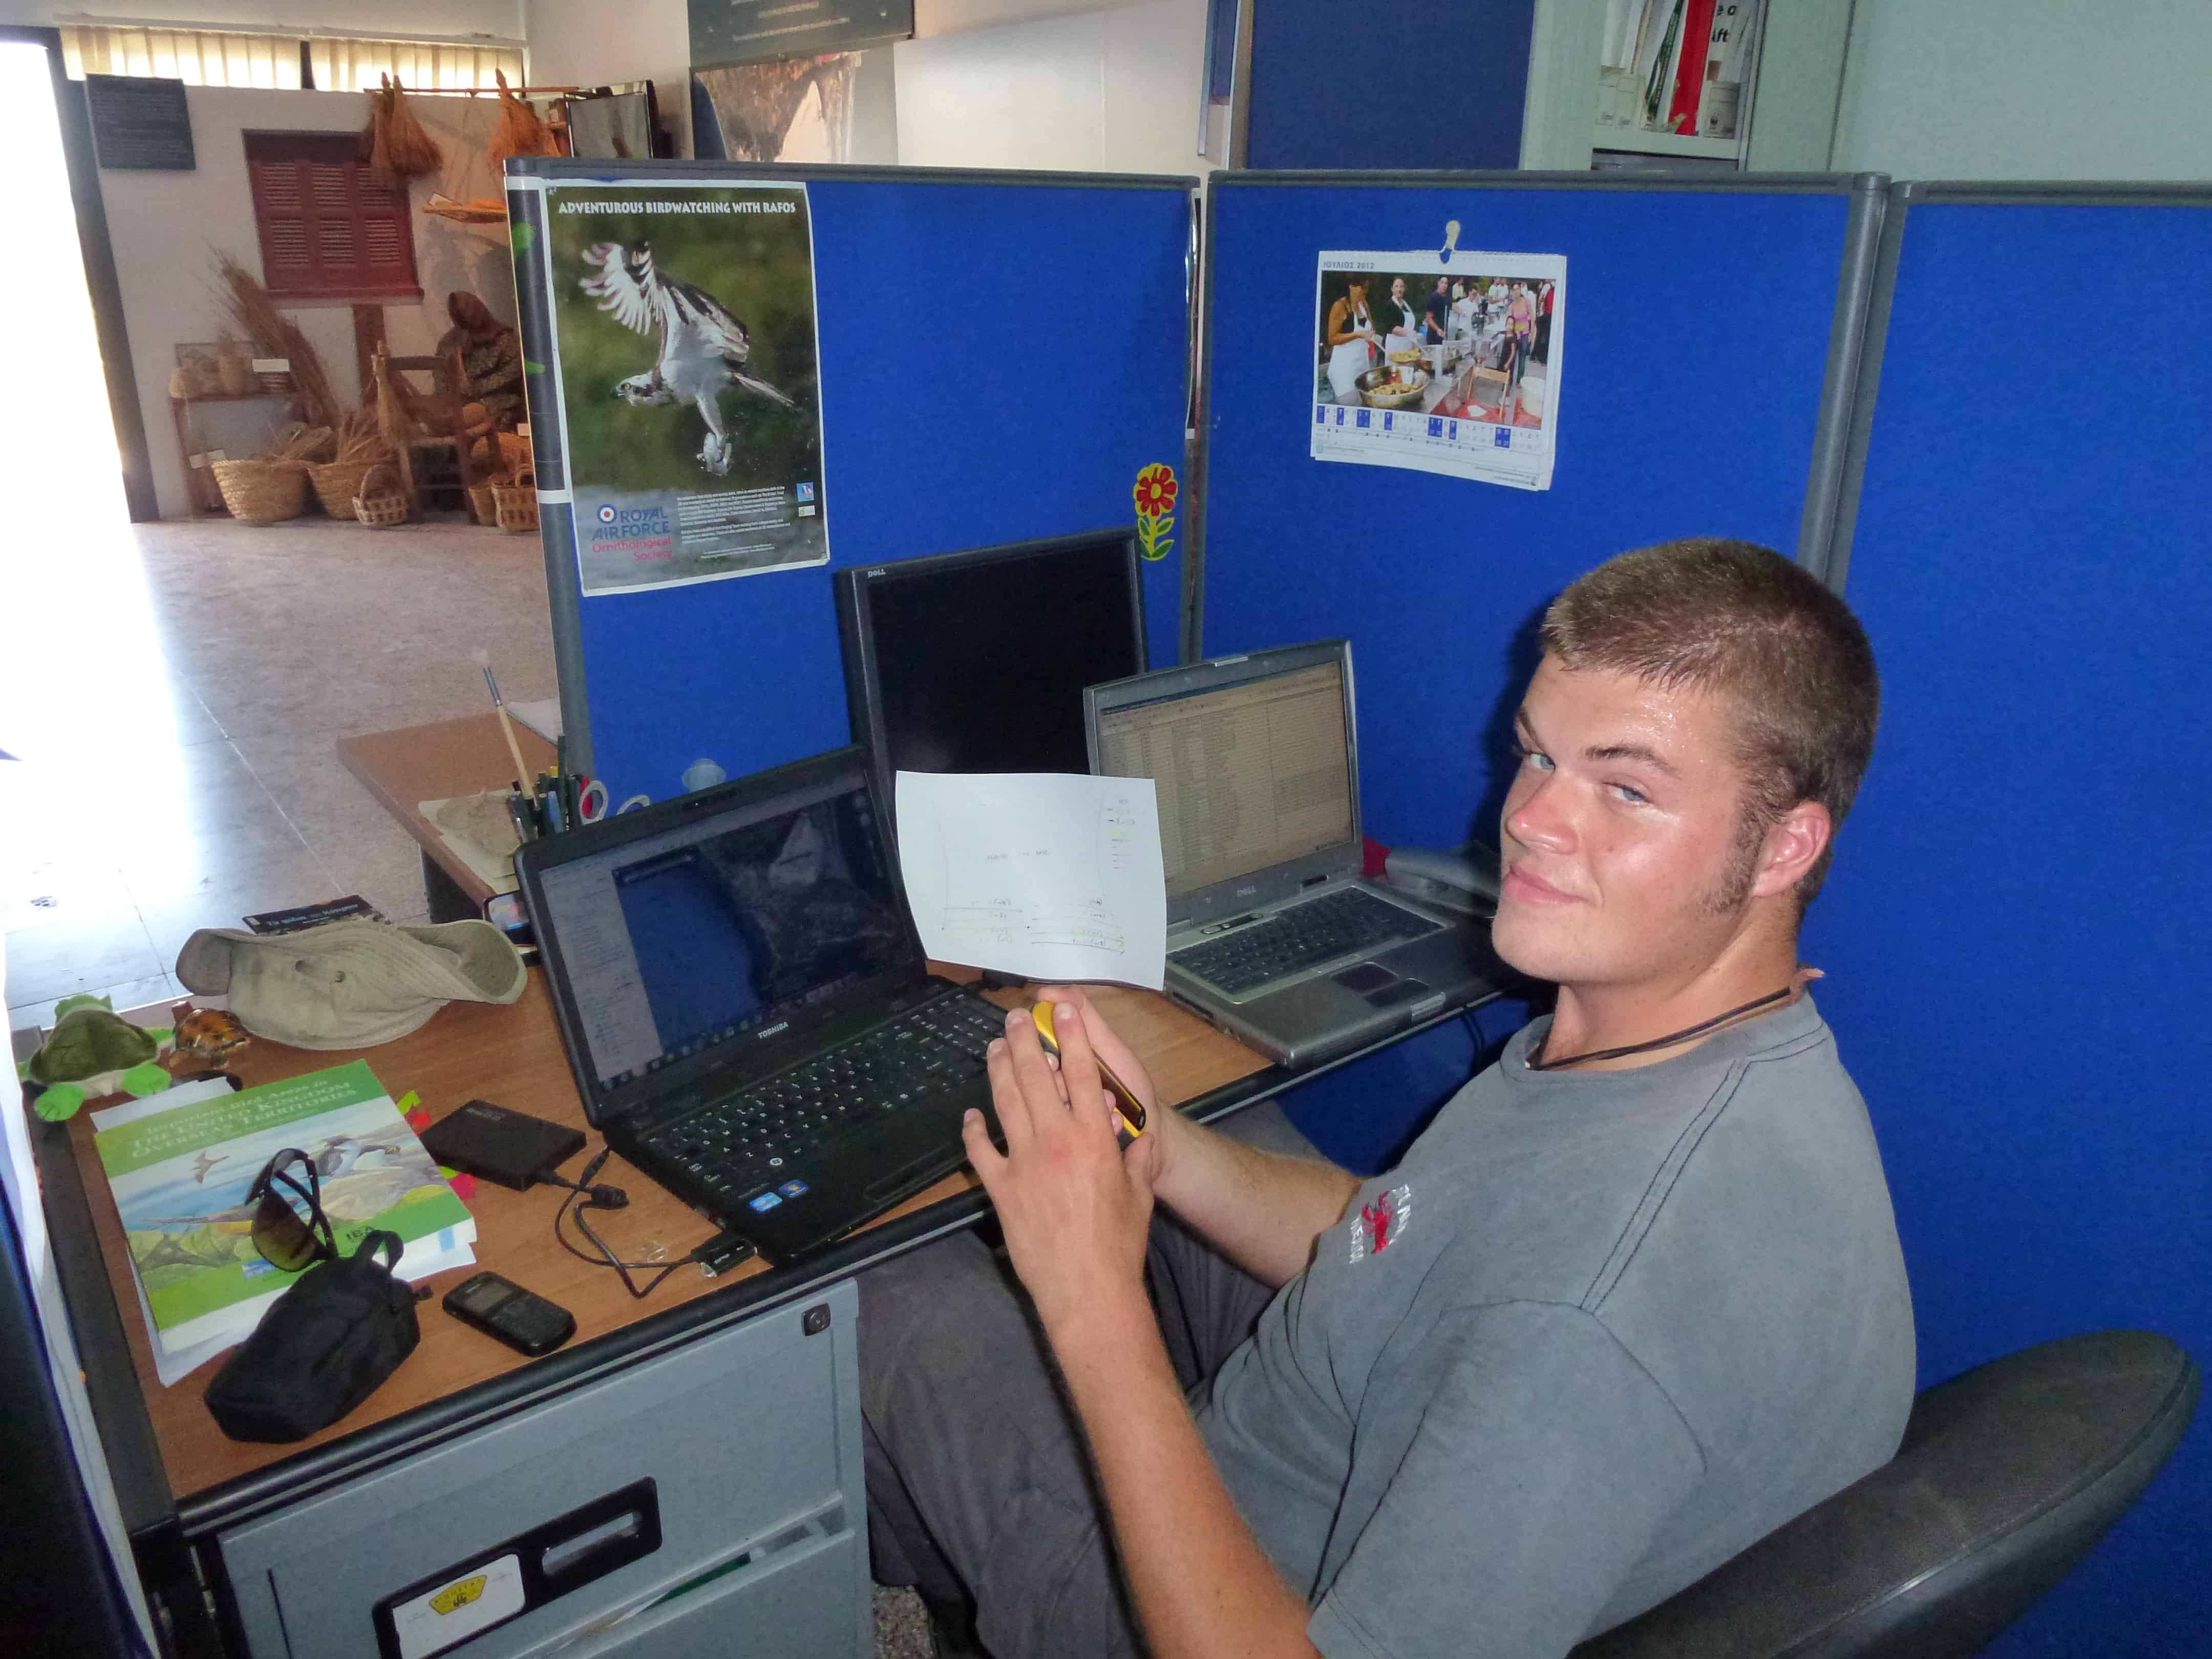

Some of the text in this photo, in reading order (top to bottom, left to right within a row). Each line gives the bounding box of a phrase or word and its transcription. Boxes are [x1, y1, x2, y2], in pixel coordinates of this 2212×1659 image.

[559, 201, 796, 214] ADVENTUROUS BIRDWATCHING WITH RAFOS
[620, 506, 668, 523] ROYAL
[592, 525, 620, 541] AIR
[621, 521, 672, 538] FORCE
[592, 536, 671, 553] Ornithological
[633, 550, 672, 562] Society
[867, 568, 886, 578] DELL
[1237, 885, 1257, 898] DELL
[757, 1021, 789, 1039] TOSHIBA
